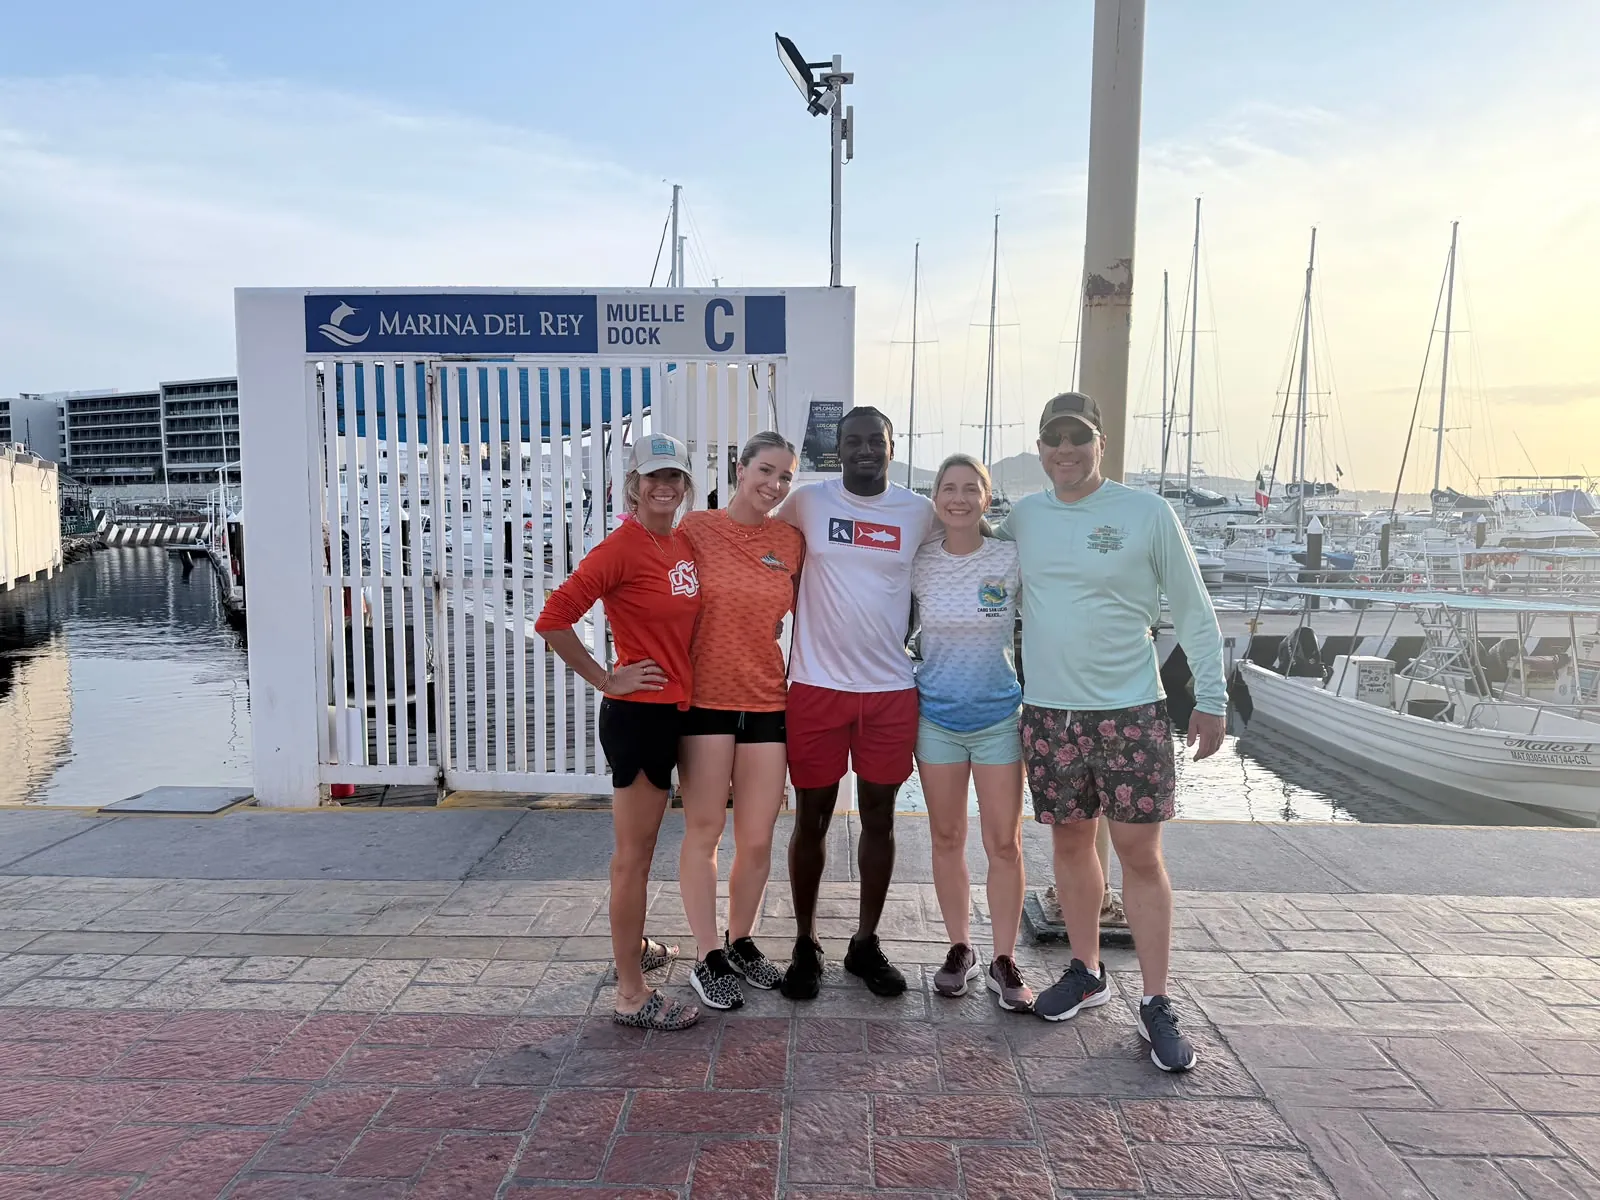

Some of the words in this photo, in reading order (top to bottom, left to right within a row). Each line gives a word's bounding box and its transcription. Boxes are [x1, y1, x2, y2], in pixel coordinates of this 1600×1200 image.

[378, 310, 479, 336] MARINA
[484, 312, 530, 336] DEL
[540, 310, 584, 336] REY
[607, 303, 685, 323] MUELLE
[704, 298, 734, 353] C
[607, 326, 661, 346] DOCK
[1504, 739, 1578, 752] Mako
